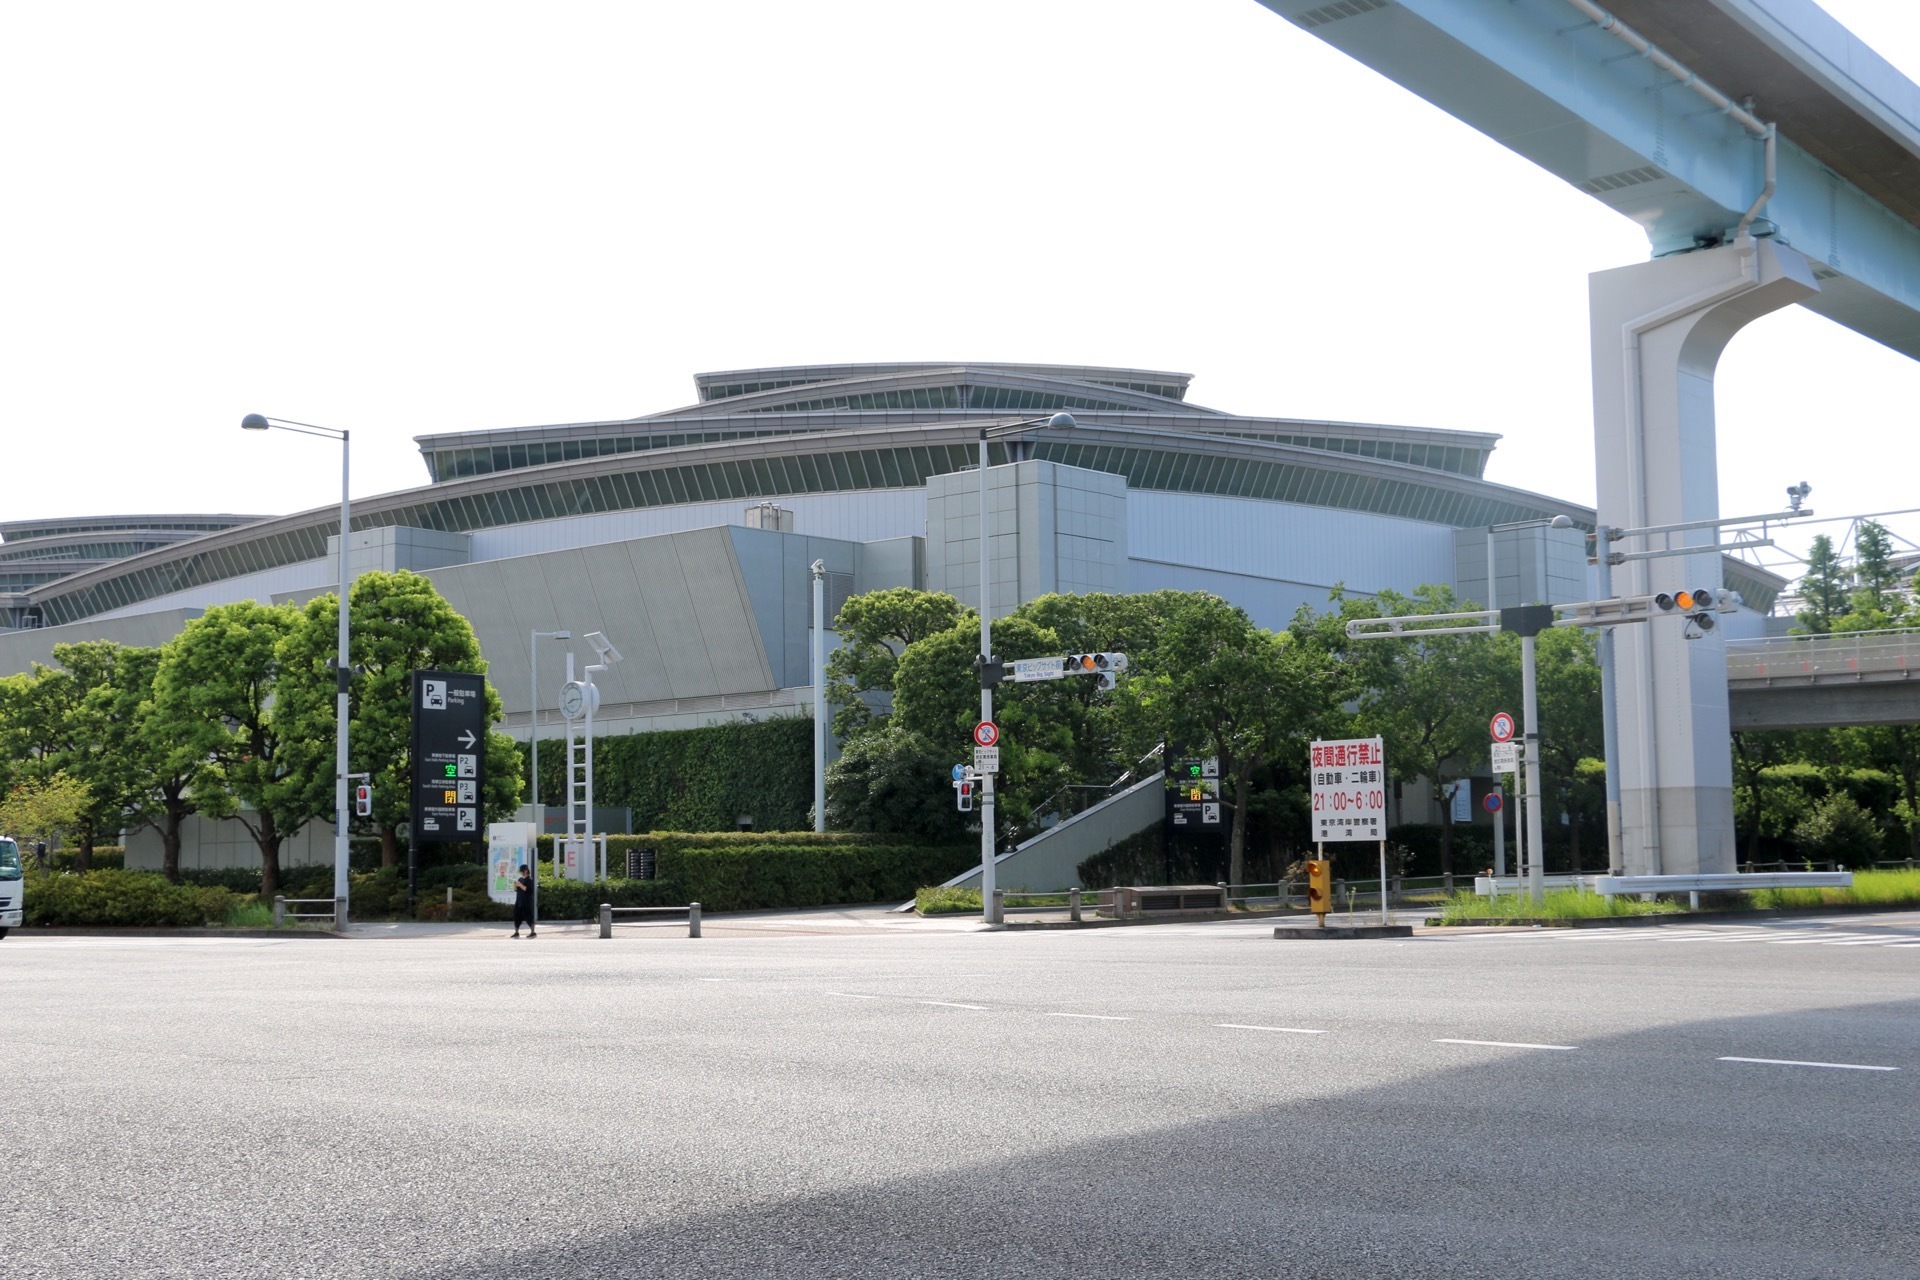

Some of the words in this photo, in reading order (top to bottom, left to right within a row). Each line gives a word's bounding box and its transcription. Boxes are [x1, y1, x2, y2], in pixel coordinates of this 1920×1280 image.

[1016, 660, 1062, 672] 東京ビッグサイト前
[426, 684, 434, 696] P
[448, 697, 465, 705] Parking
[1312, 742, 1381, 768] 夜間通行禁止
[445, 764, 456, 777] 空
[459, 783, 469, 791] P3
[445, 791, 456, 803] 閉
[460, 810, 467, 821] P
[1205, 805, 1211, 815] P
[1320, 818, 1377, 826] 東京湾岸警察署
[567, 851, 575, 867] E
